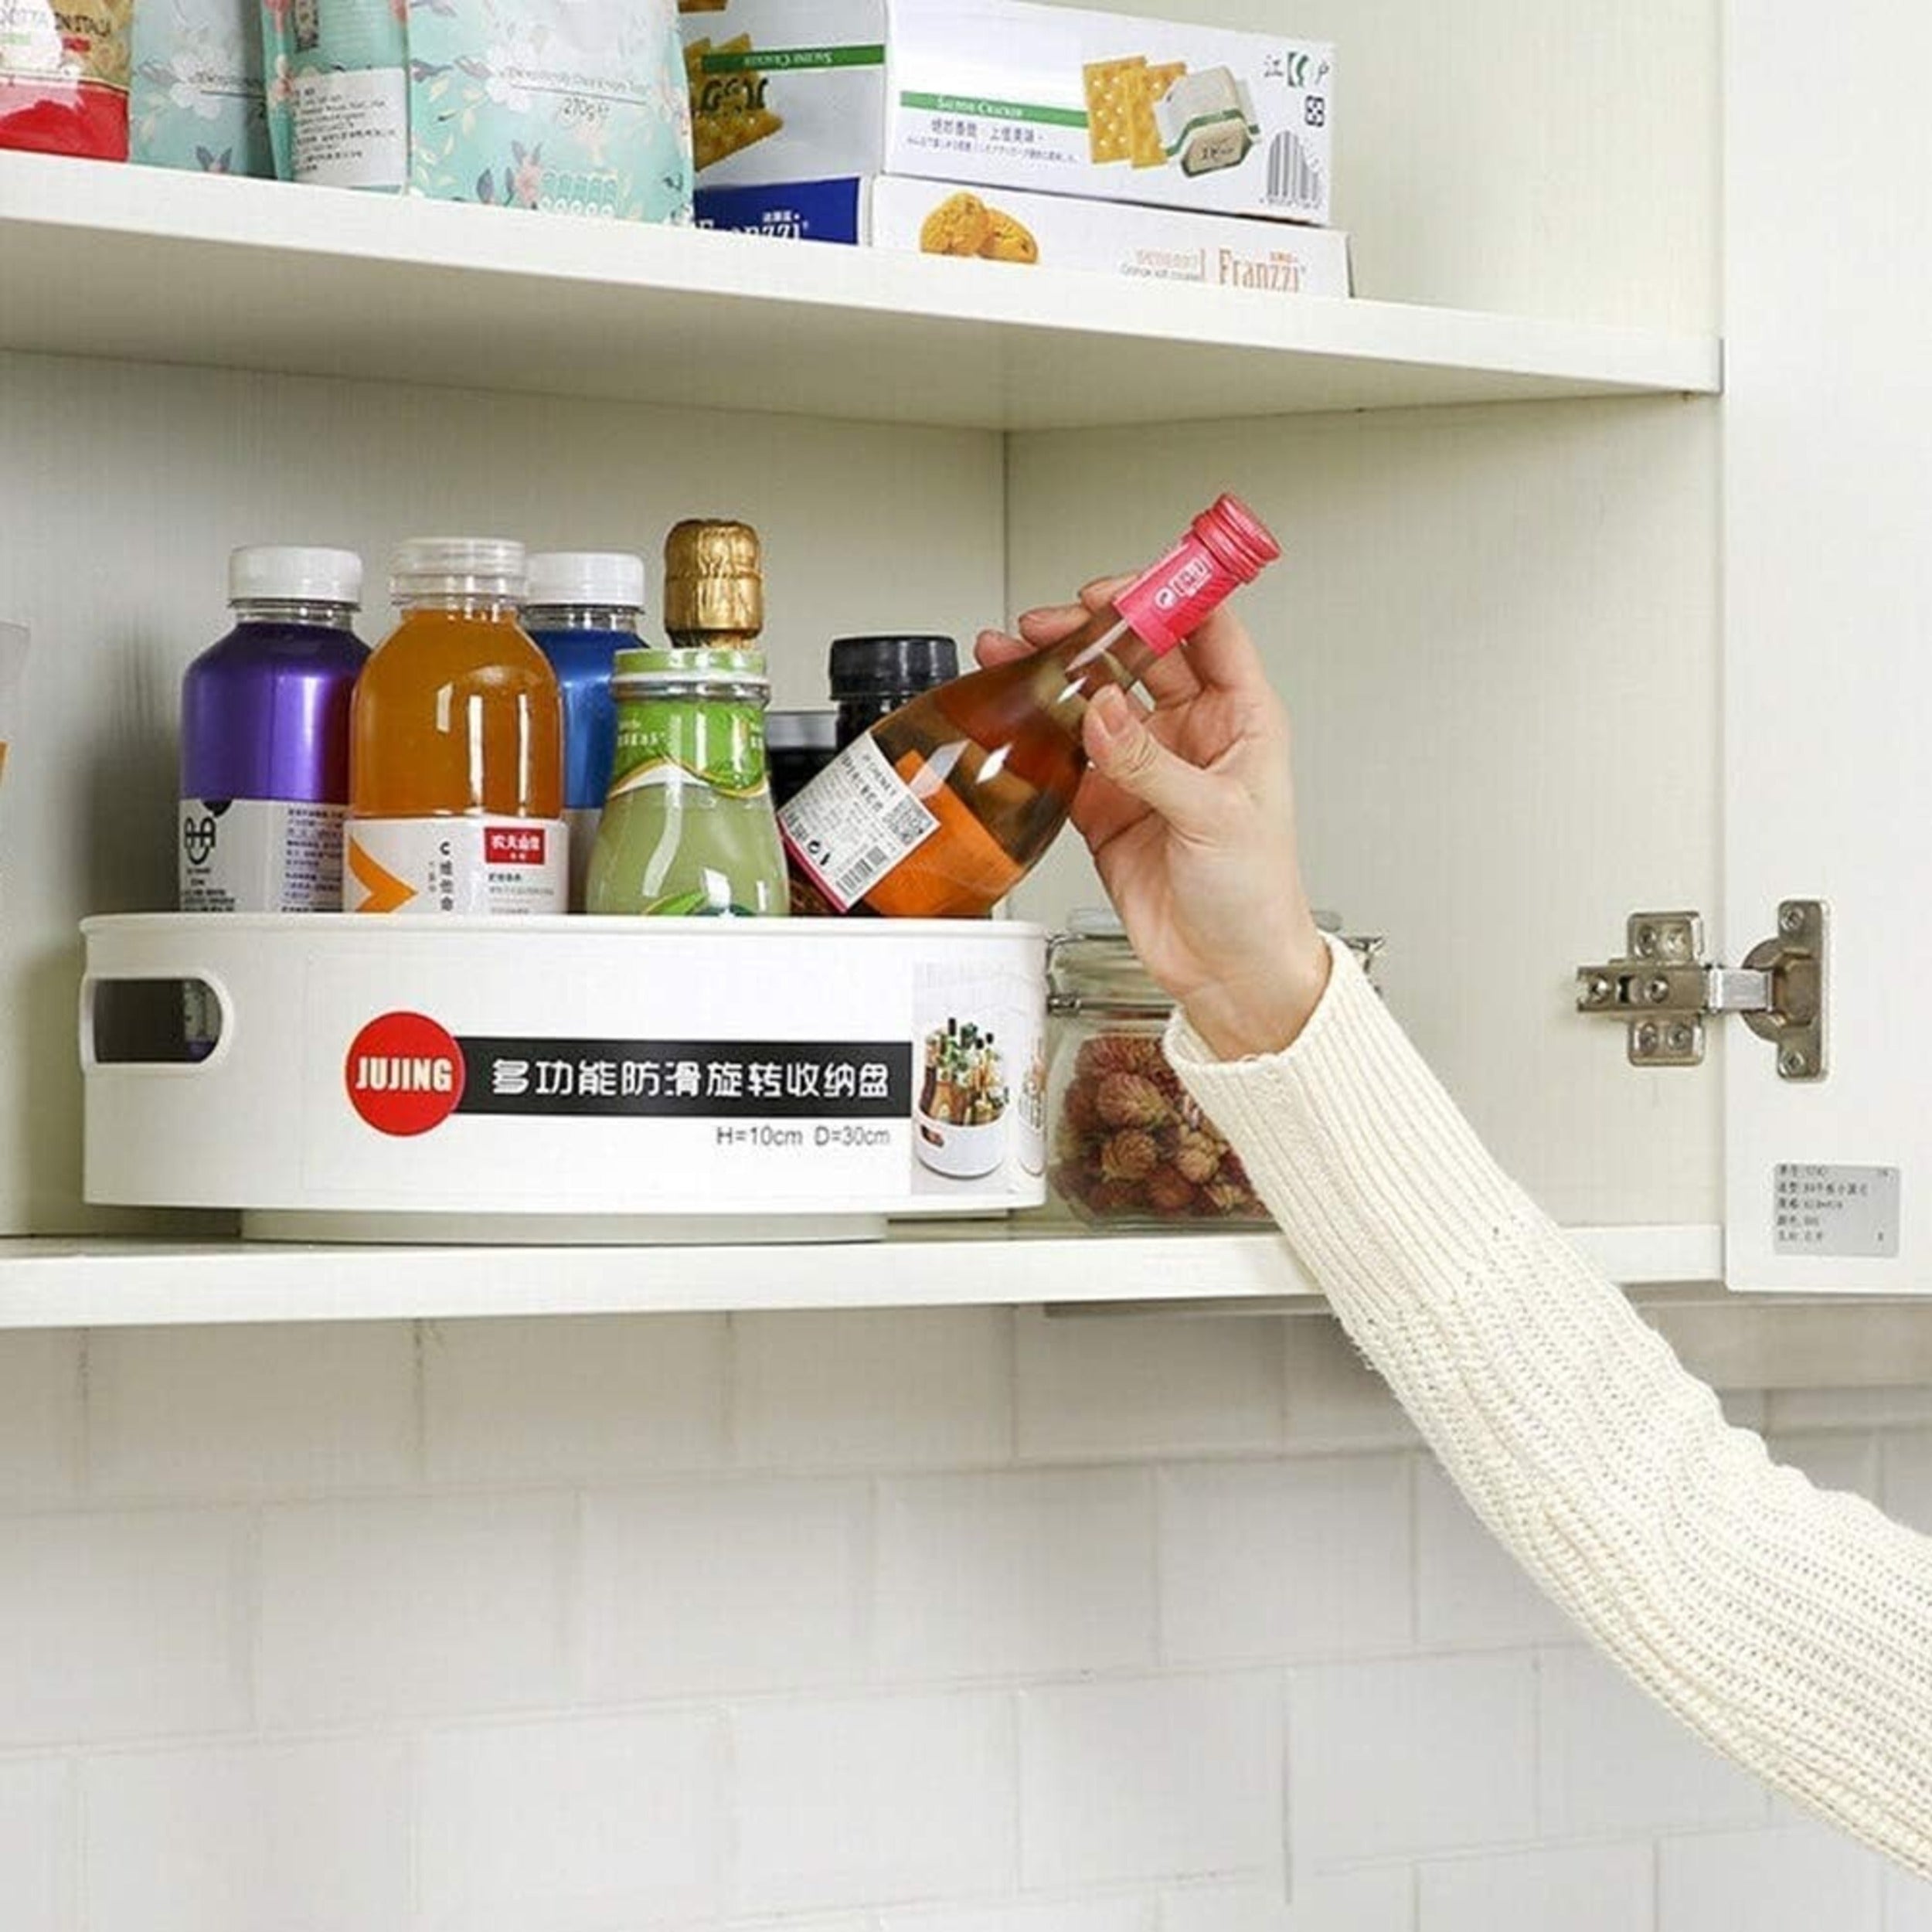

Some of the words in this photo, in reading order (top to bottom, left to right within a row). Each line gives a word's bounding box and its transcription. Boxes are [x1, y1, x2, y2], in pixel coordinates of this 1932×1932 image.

[1219, 247, 1299, 294] Franzzi
[355, 1056, 453, 1093] JUJING
[492, 1059, 889, 1098] 多功能防滑旋转收纳盘
[716, 1127, 804, 1147] H=10cm
[814, 1127, 890, 1147] D=30cm
